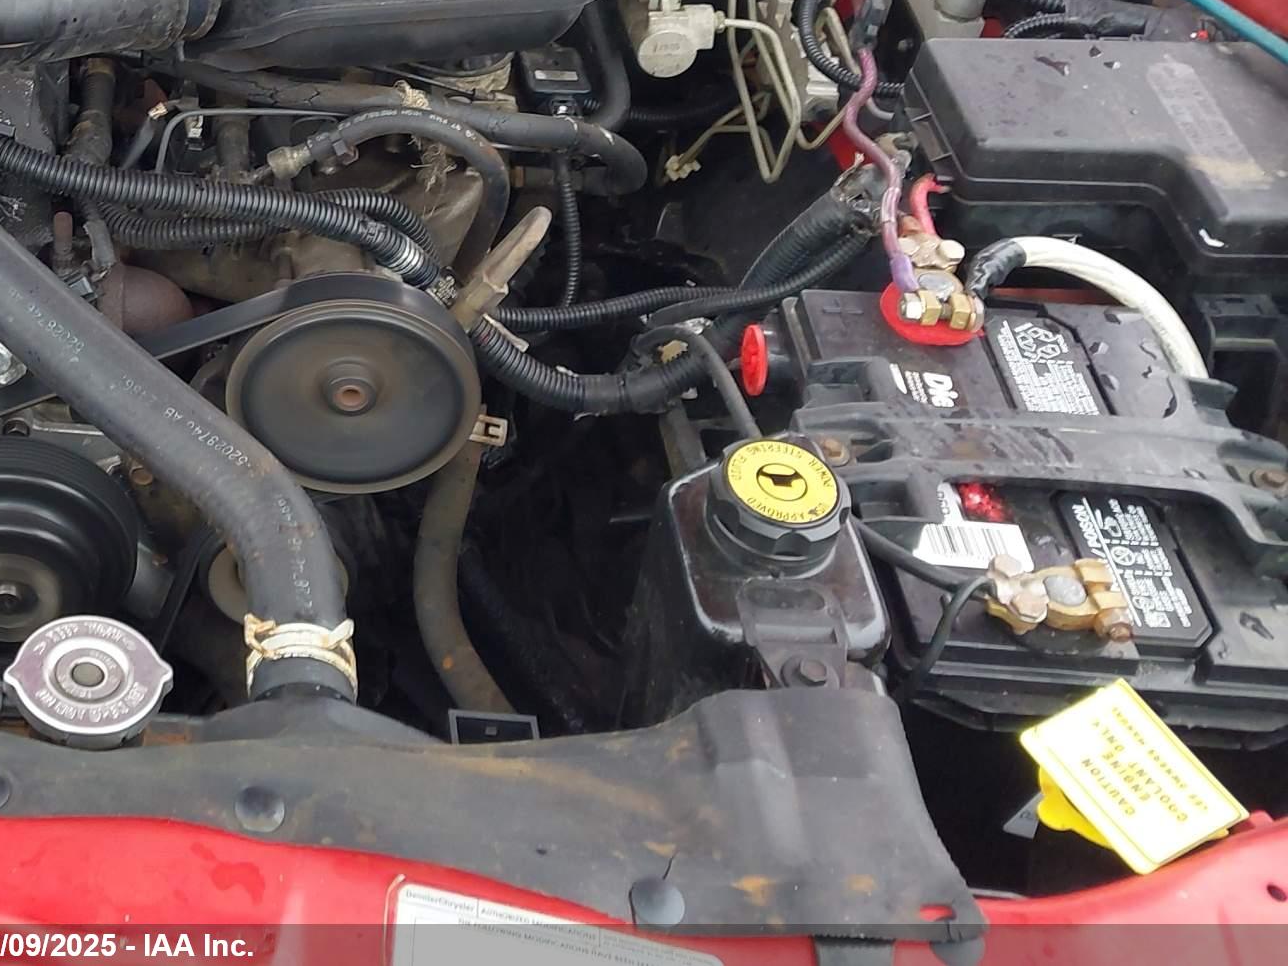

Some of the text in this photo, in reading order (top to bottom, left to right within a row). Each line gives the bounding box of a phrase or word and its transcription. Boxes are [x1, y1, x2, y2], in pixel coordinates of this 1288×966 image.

[1082, 758, 1136, 816] CAUTION
[1103, 751, 1151, 802] ENGINE
[1127, 761, 1189, 822] COOLANT
